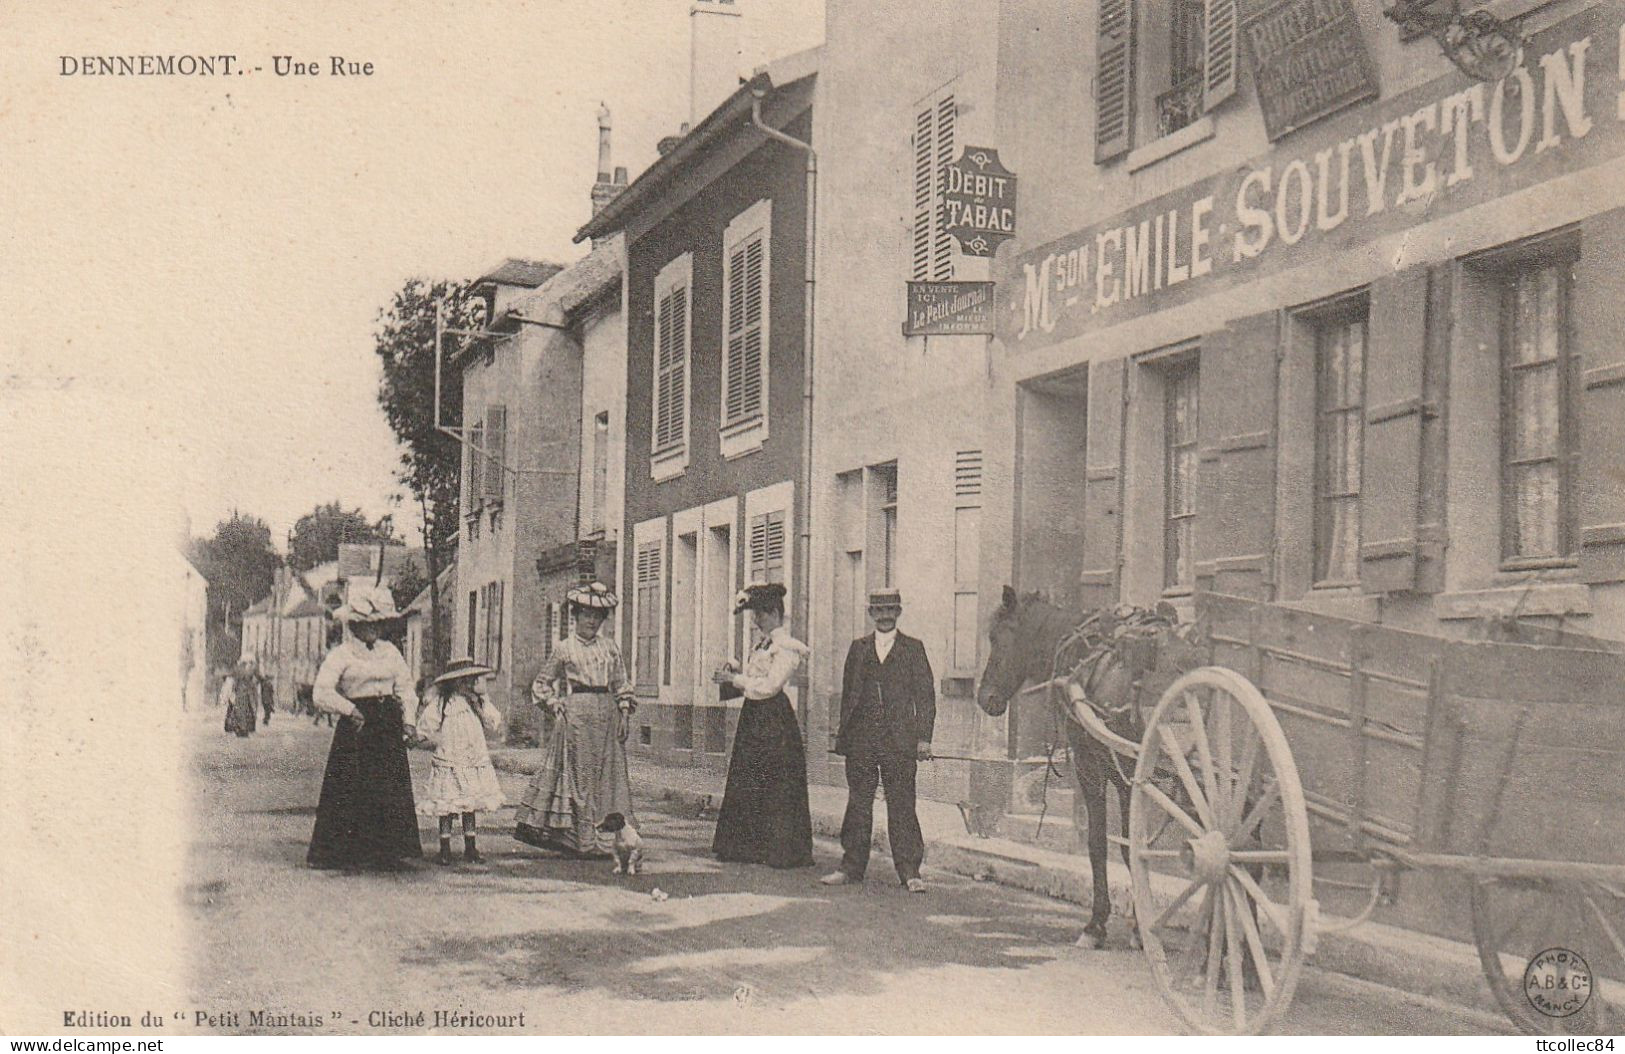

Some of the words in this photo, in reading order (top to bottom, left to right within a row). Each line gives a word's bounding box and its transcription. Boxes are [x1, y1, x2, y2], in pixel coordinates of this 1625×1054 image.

[1233, 36, 1594, 263] SOUVETON
[946, 199, 1013, 232] TABAC
[913, 310, 926, 330] Le
[926, 299, 950, 325] Petit
[950, 284, 987, 315] Journal
[917, 294, 937, 303] ICI
